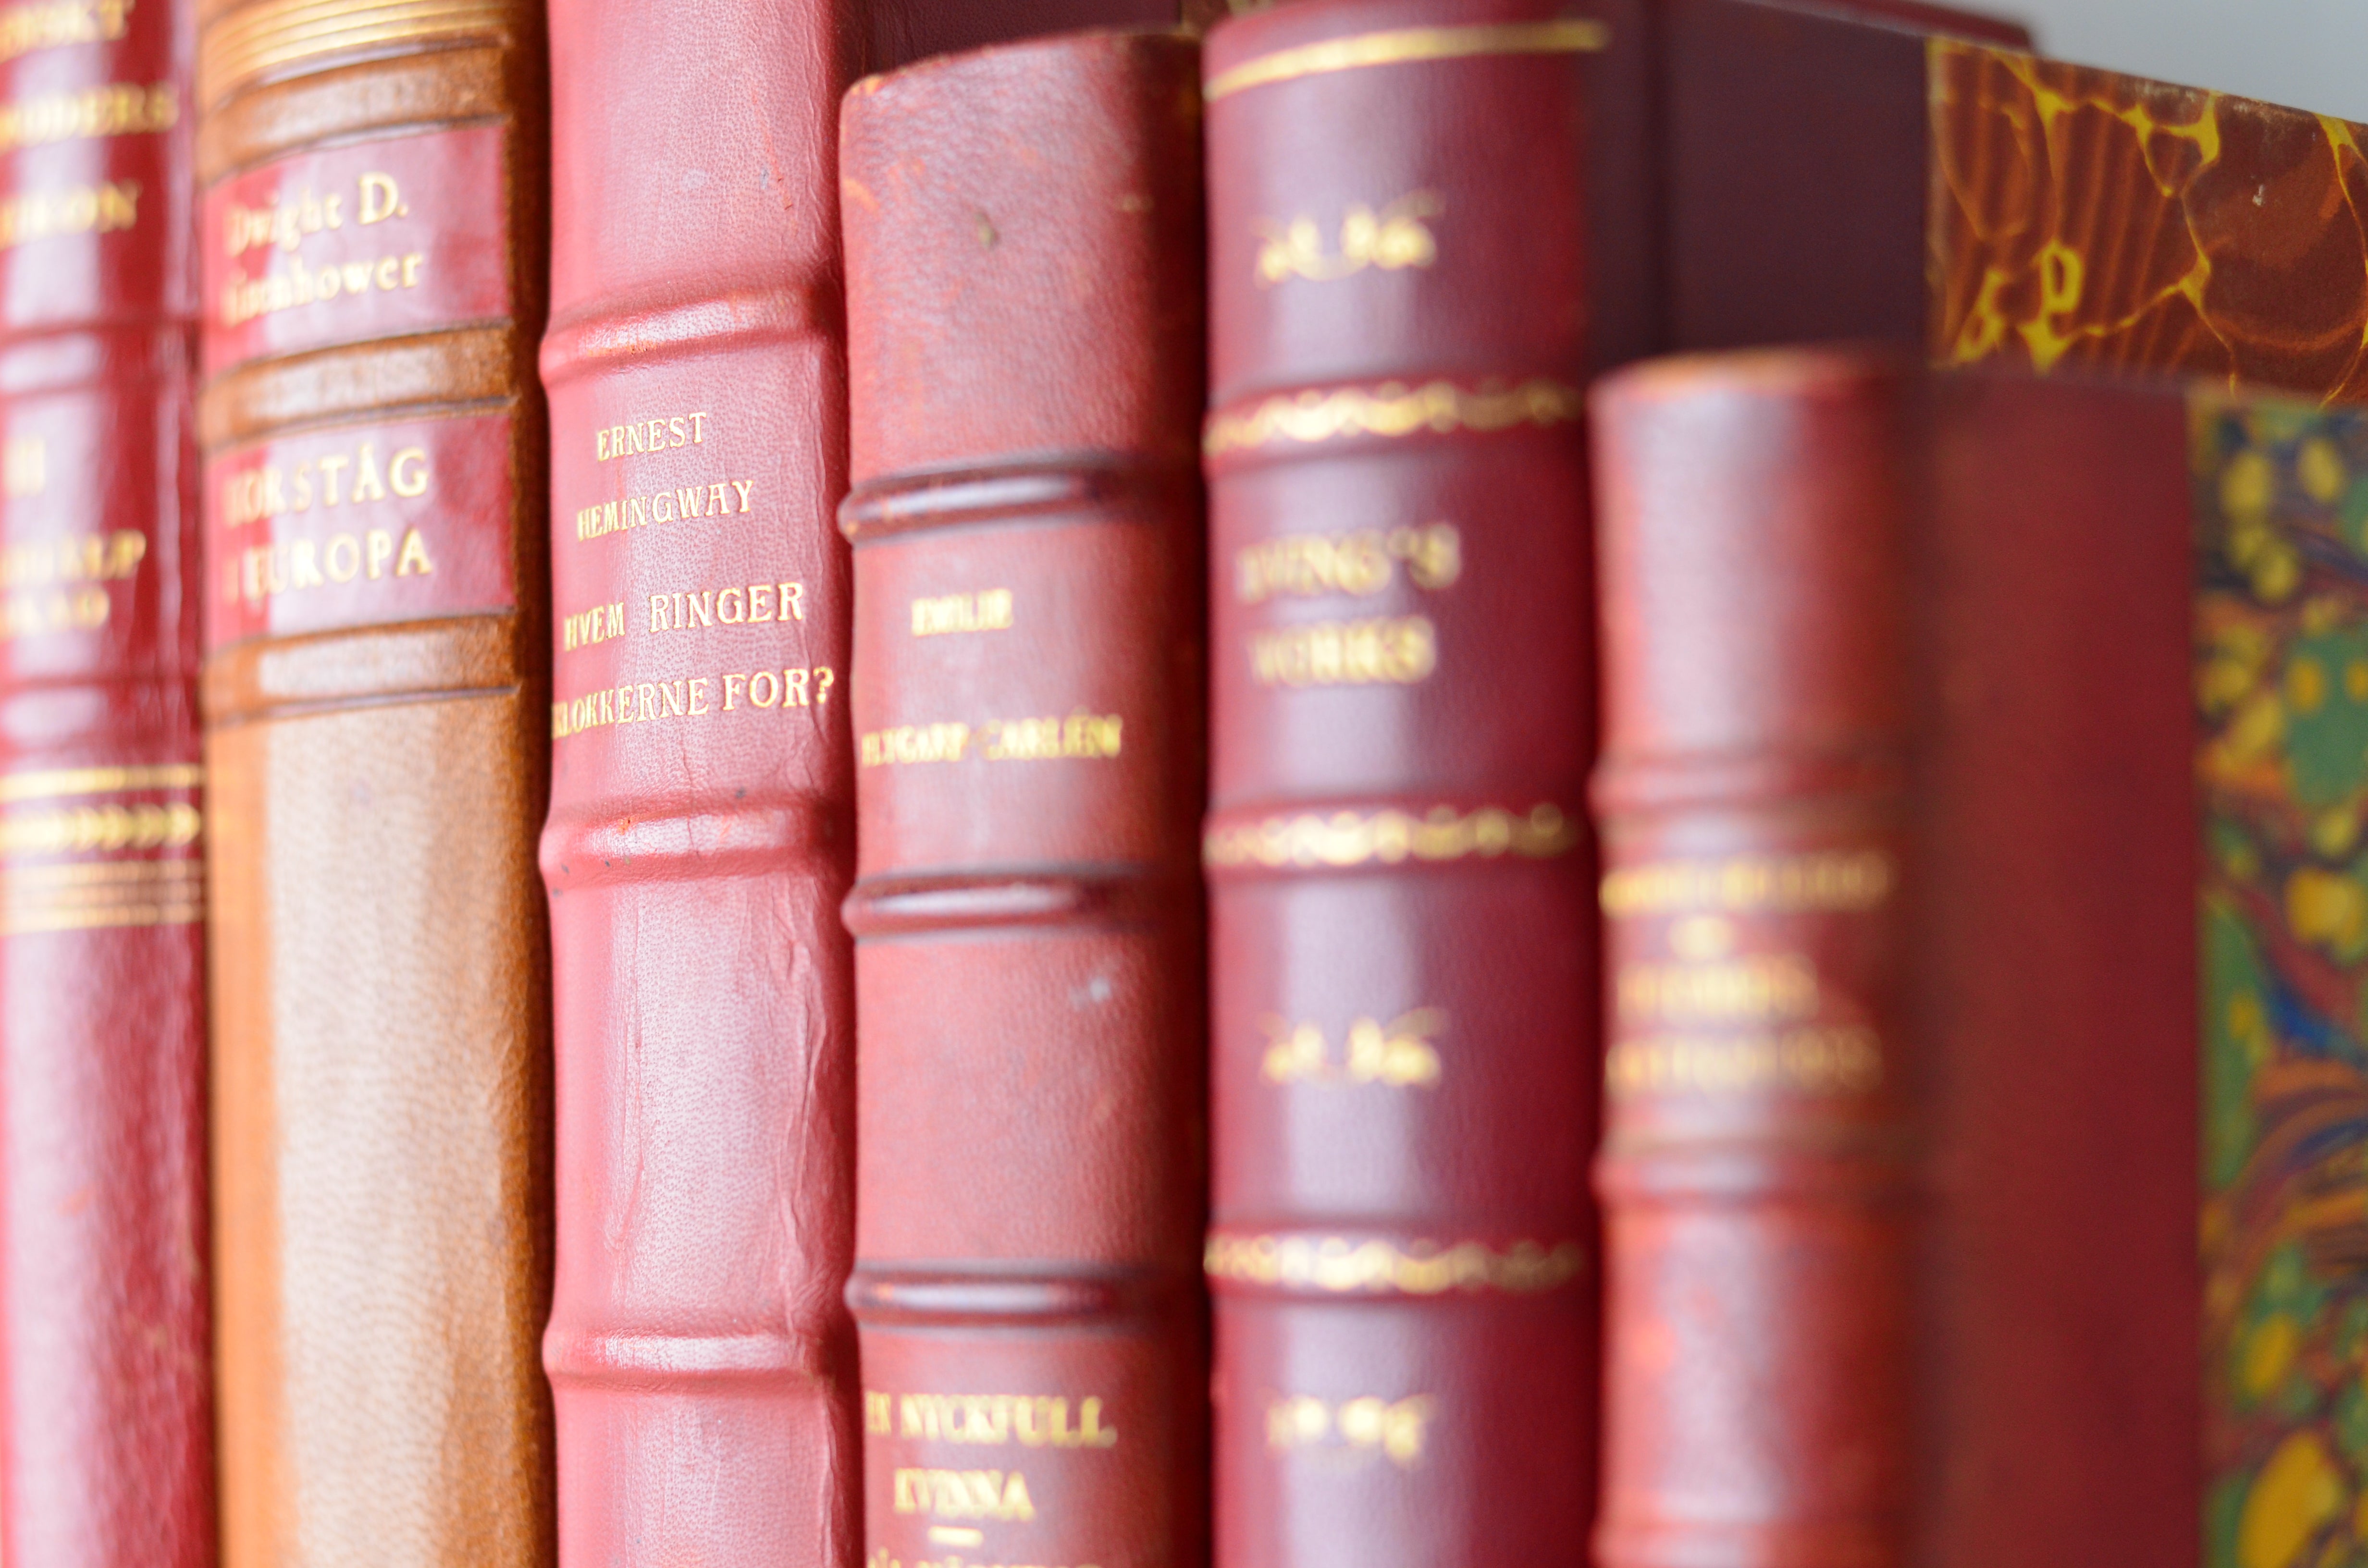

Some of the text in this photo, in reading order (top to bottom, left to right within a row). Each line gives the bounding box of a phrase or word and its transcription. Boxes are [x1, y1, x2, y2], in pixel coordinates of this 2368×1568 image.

[359, 171, 409, 225] D.
[597, 412, 706, 462] ERNEST
[577, 480, 753, 541] HEMINGWAY
[563, 581, 804, 651] HVEM RINGER
[722, 667, 834, 711] FOR?
